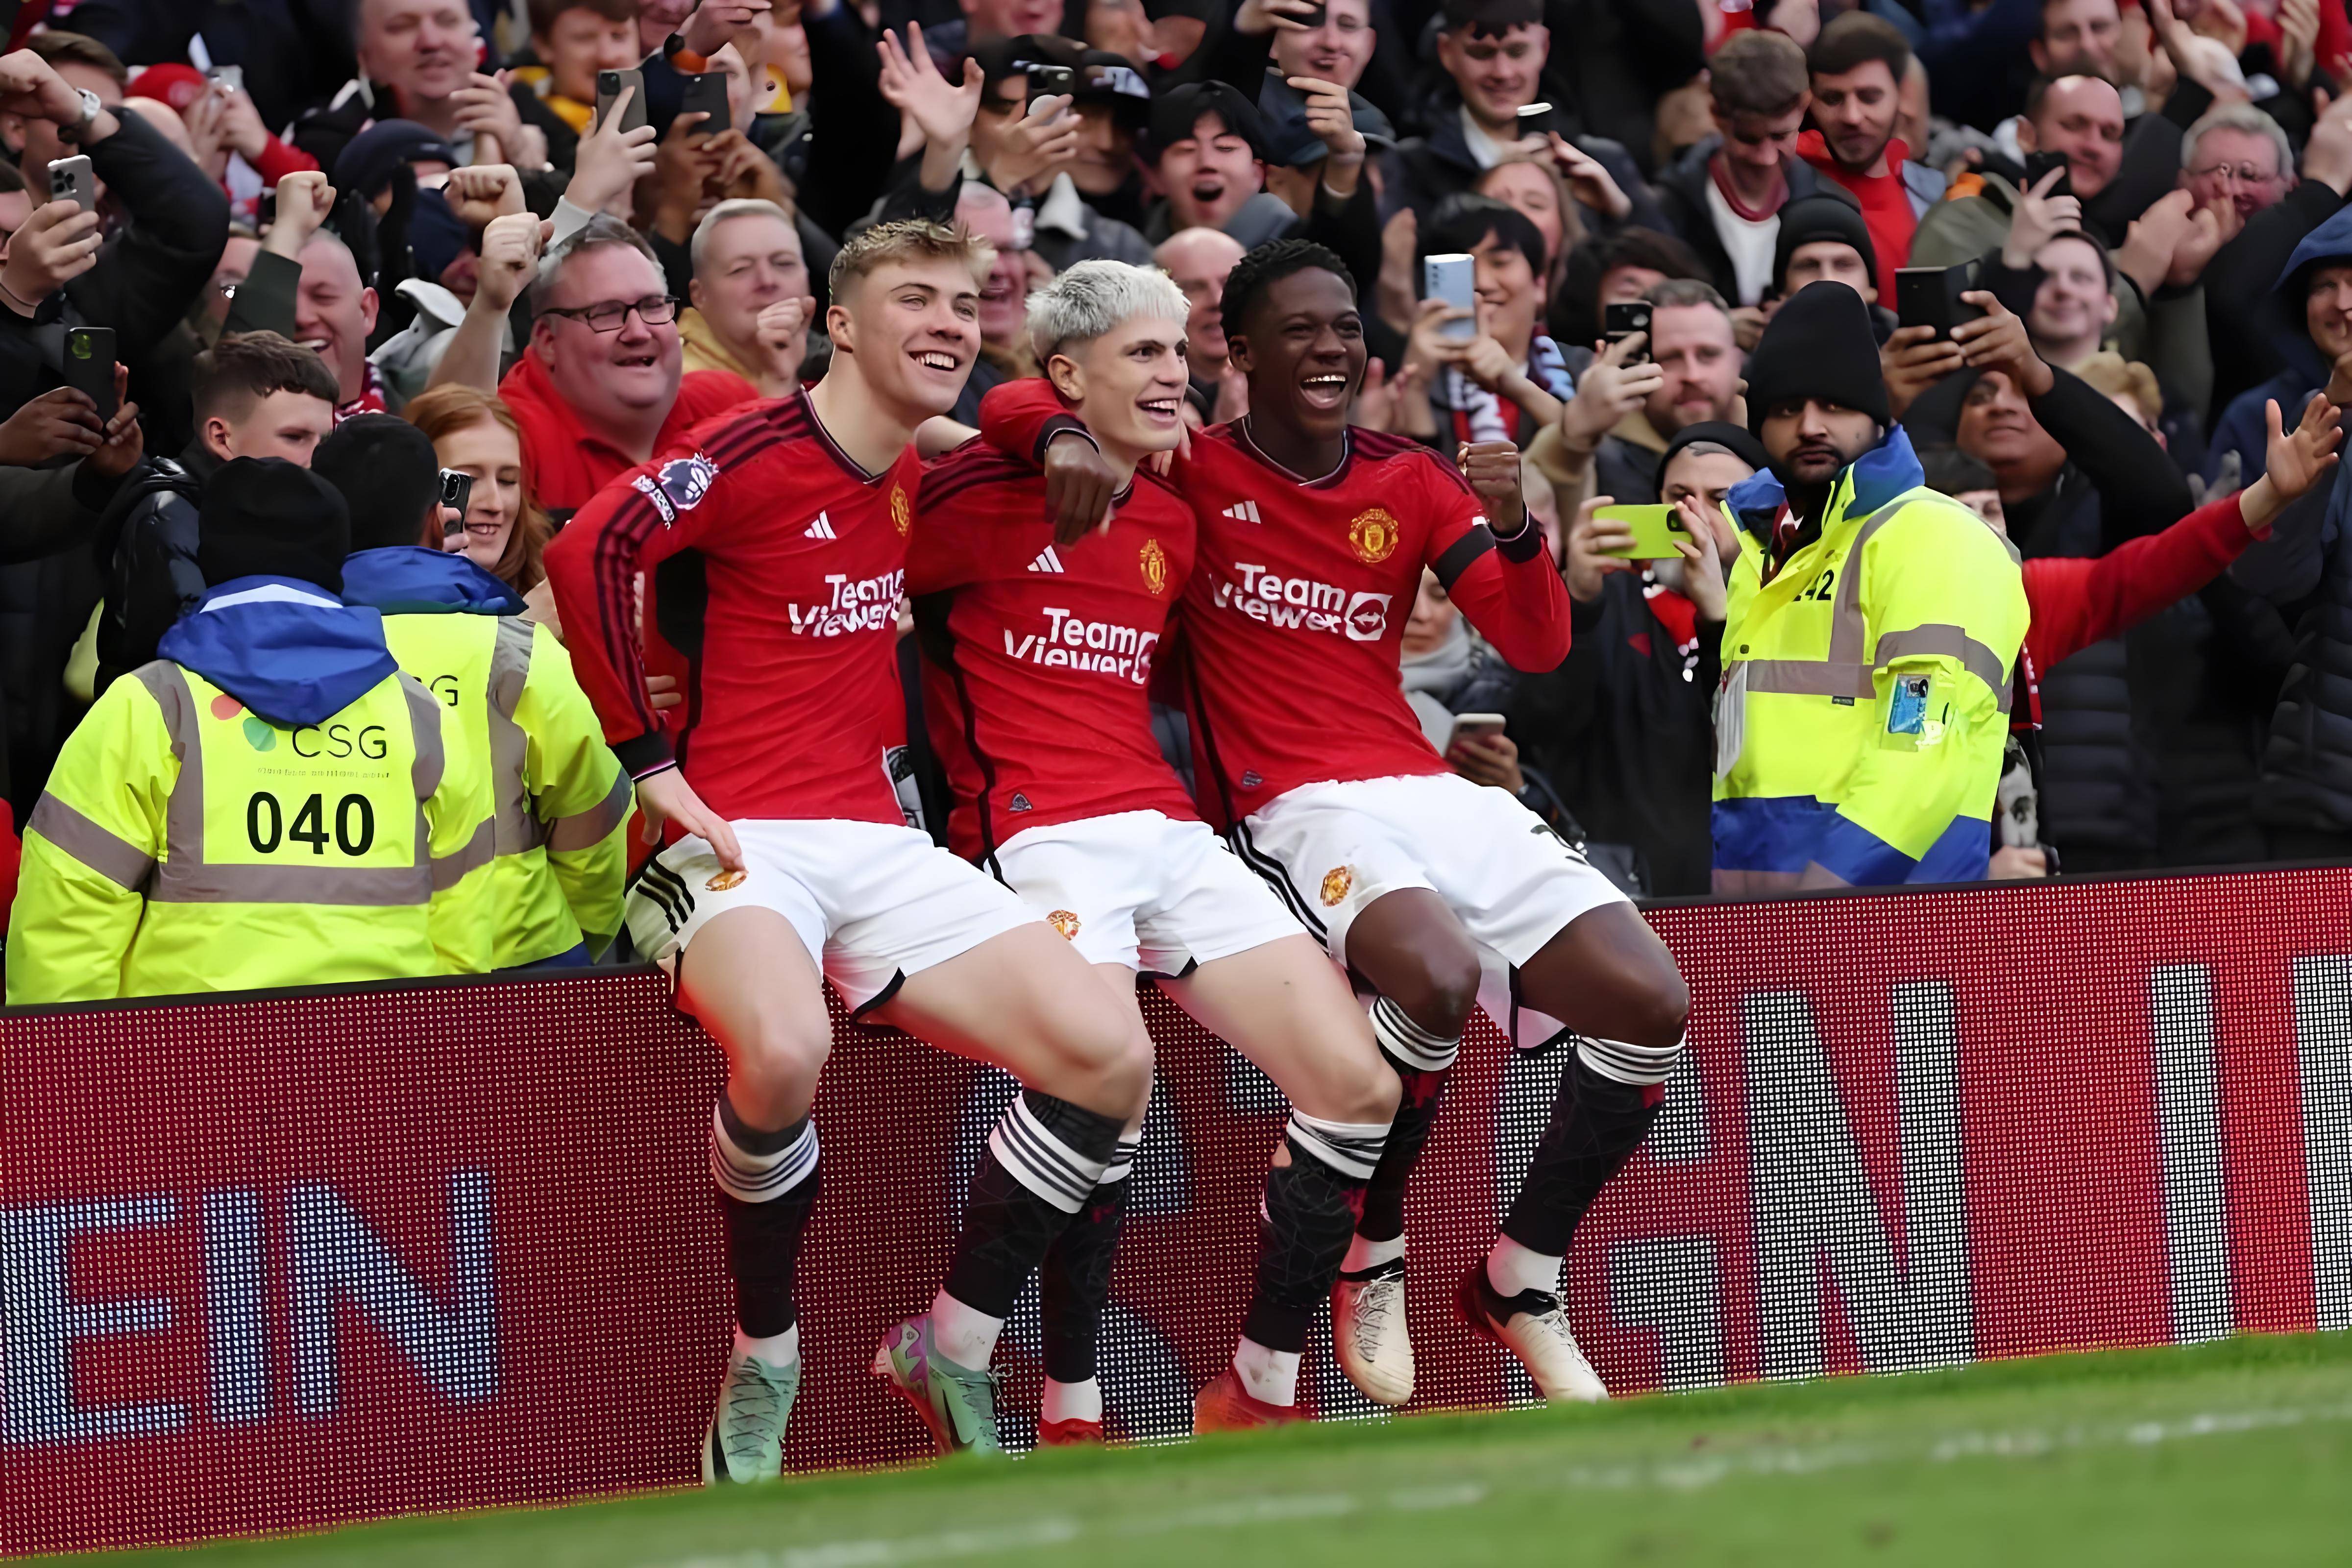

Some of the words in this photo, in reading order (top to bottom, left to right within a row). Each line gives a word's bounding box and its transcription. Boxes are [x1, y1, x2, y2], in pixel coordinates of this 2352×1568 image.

[825, 572, 895, 611] Team
[1208, 573, 1342, 634] Viewer
[1234, 562, 1346, 612] Team
[788, 603, 892, 637] Viewer
[1043, 607, 1137, 655] Team
[1004, 627, 1132, 678] Viewer
[293, 724, 387, 759] CSG
[247, 791, 374, 856] 040
[0, 1164, 498, 1443] EIN
